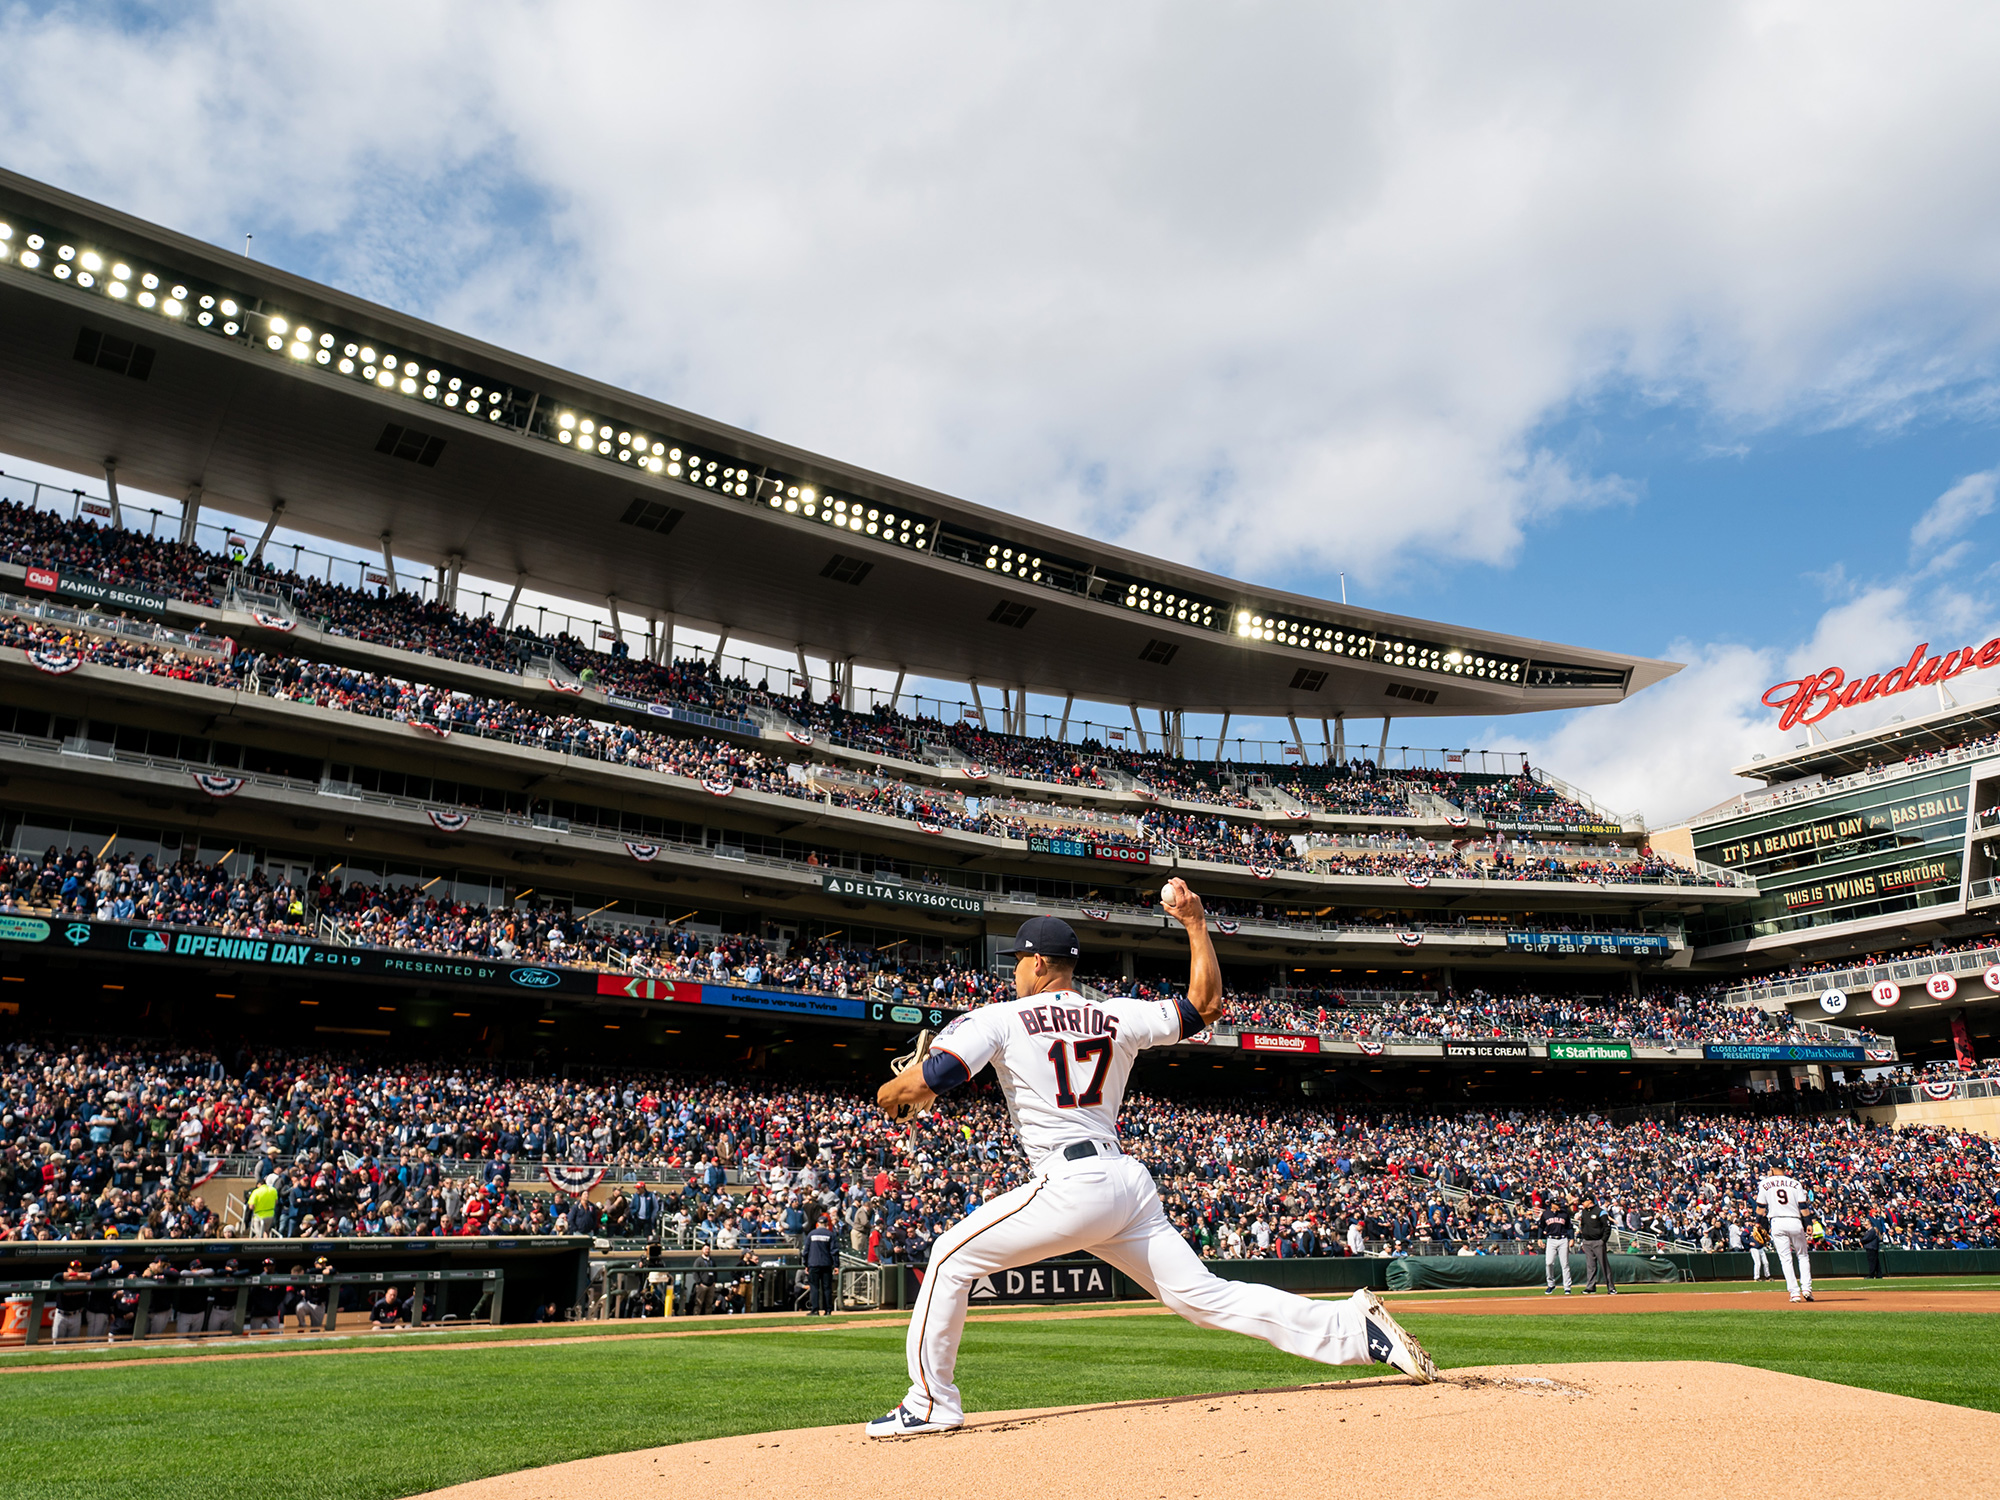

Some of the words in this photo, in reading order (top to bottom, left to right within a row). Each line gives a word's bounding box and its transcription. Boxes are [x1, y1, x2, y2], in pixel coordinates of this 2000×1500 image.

[29, 572, 53, 586] Cub
[60, 580, 106, 597] FAMILY
[110, 590, 164, 610] SECTION
[610, 696, 636, 709] STRIKEOUT
[1496, 821, 1516, 830] Report
[1517, 822, 1542, 832] Security
[1565, 824, 1578, 832] Text
[1723, 842, 1750, 863] IT'S
[1753, 840, 1762, 856] A
[1764, 824, 1836, 854] BEAUTIFUL
[1838, 818, 1863, 837] DAY
[1869, 816, 1886, 829] for
[1890, 796, 1964, 826] BASEBALL
[845, 882, 893, 899] DELTA
[1784, 889, 1810, 906] THIS
[1811, 887, 1823, 901] IS
[1826, 876, 1876, 901] TWINS
[1878, 862, 1946, 887] TERRITORY
[1540, 934, 1571, 944] 8TH
[1582, 936, 1612, 945] 9TH
[1619, 937, 1658, 945] PITCHER
[175, 934, 268, 962] OPENING
[271, 943, 311, 965] DAY
[314, 952, 361, 966] 2019
[385, 959, 472, 976] PRESENTED
[479, 968, 496, 978] BY
[519, 969, 550, 985] Ford
[1990, 973, 2000, 985] 3
[1933, 980, 1949, 993] 28
[1879, 987, 1892, 1000] 10
[732, 994, 769, 1005] Indians
[772, 998, 806, 1009] versus
[809, 1002, 838, 1011] Twins
[1826, 995, 1841, 1007] 42
[1254, 1035, 1277, 1045] Edina
[1478, 1047, 1493, 1056] ICE
[1494, 1048, 1526, 1056] CREAM
[1566, 1048, 1628, 1058] StarTribune
[1805, 1050, 1824, 1058] Park
[1824, 1050, 1855, 1059] Nicollet
[1048, 1036, 1114, 1109] 17
[1762, 1180, 1799, 1191] GONZALEZ
[1777, 1189, 1788, 1205] 9
[1006, 1268, 1104, 1294] DELTA
